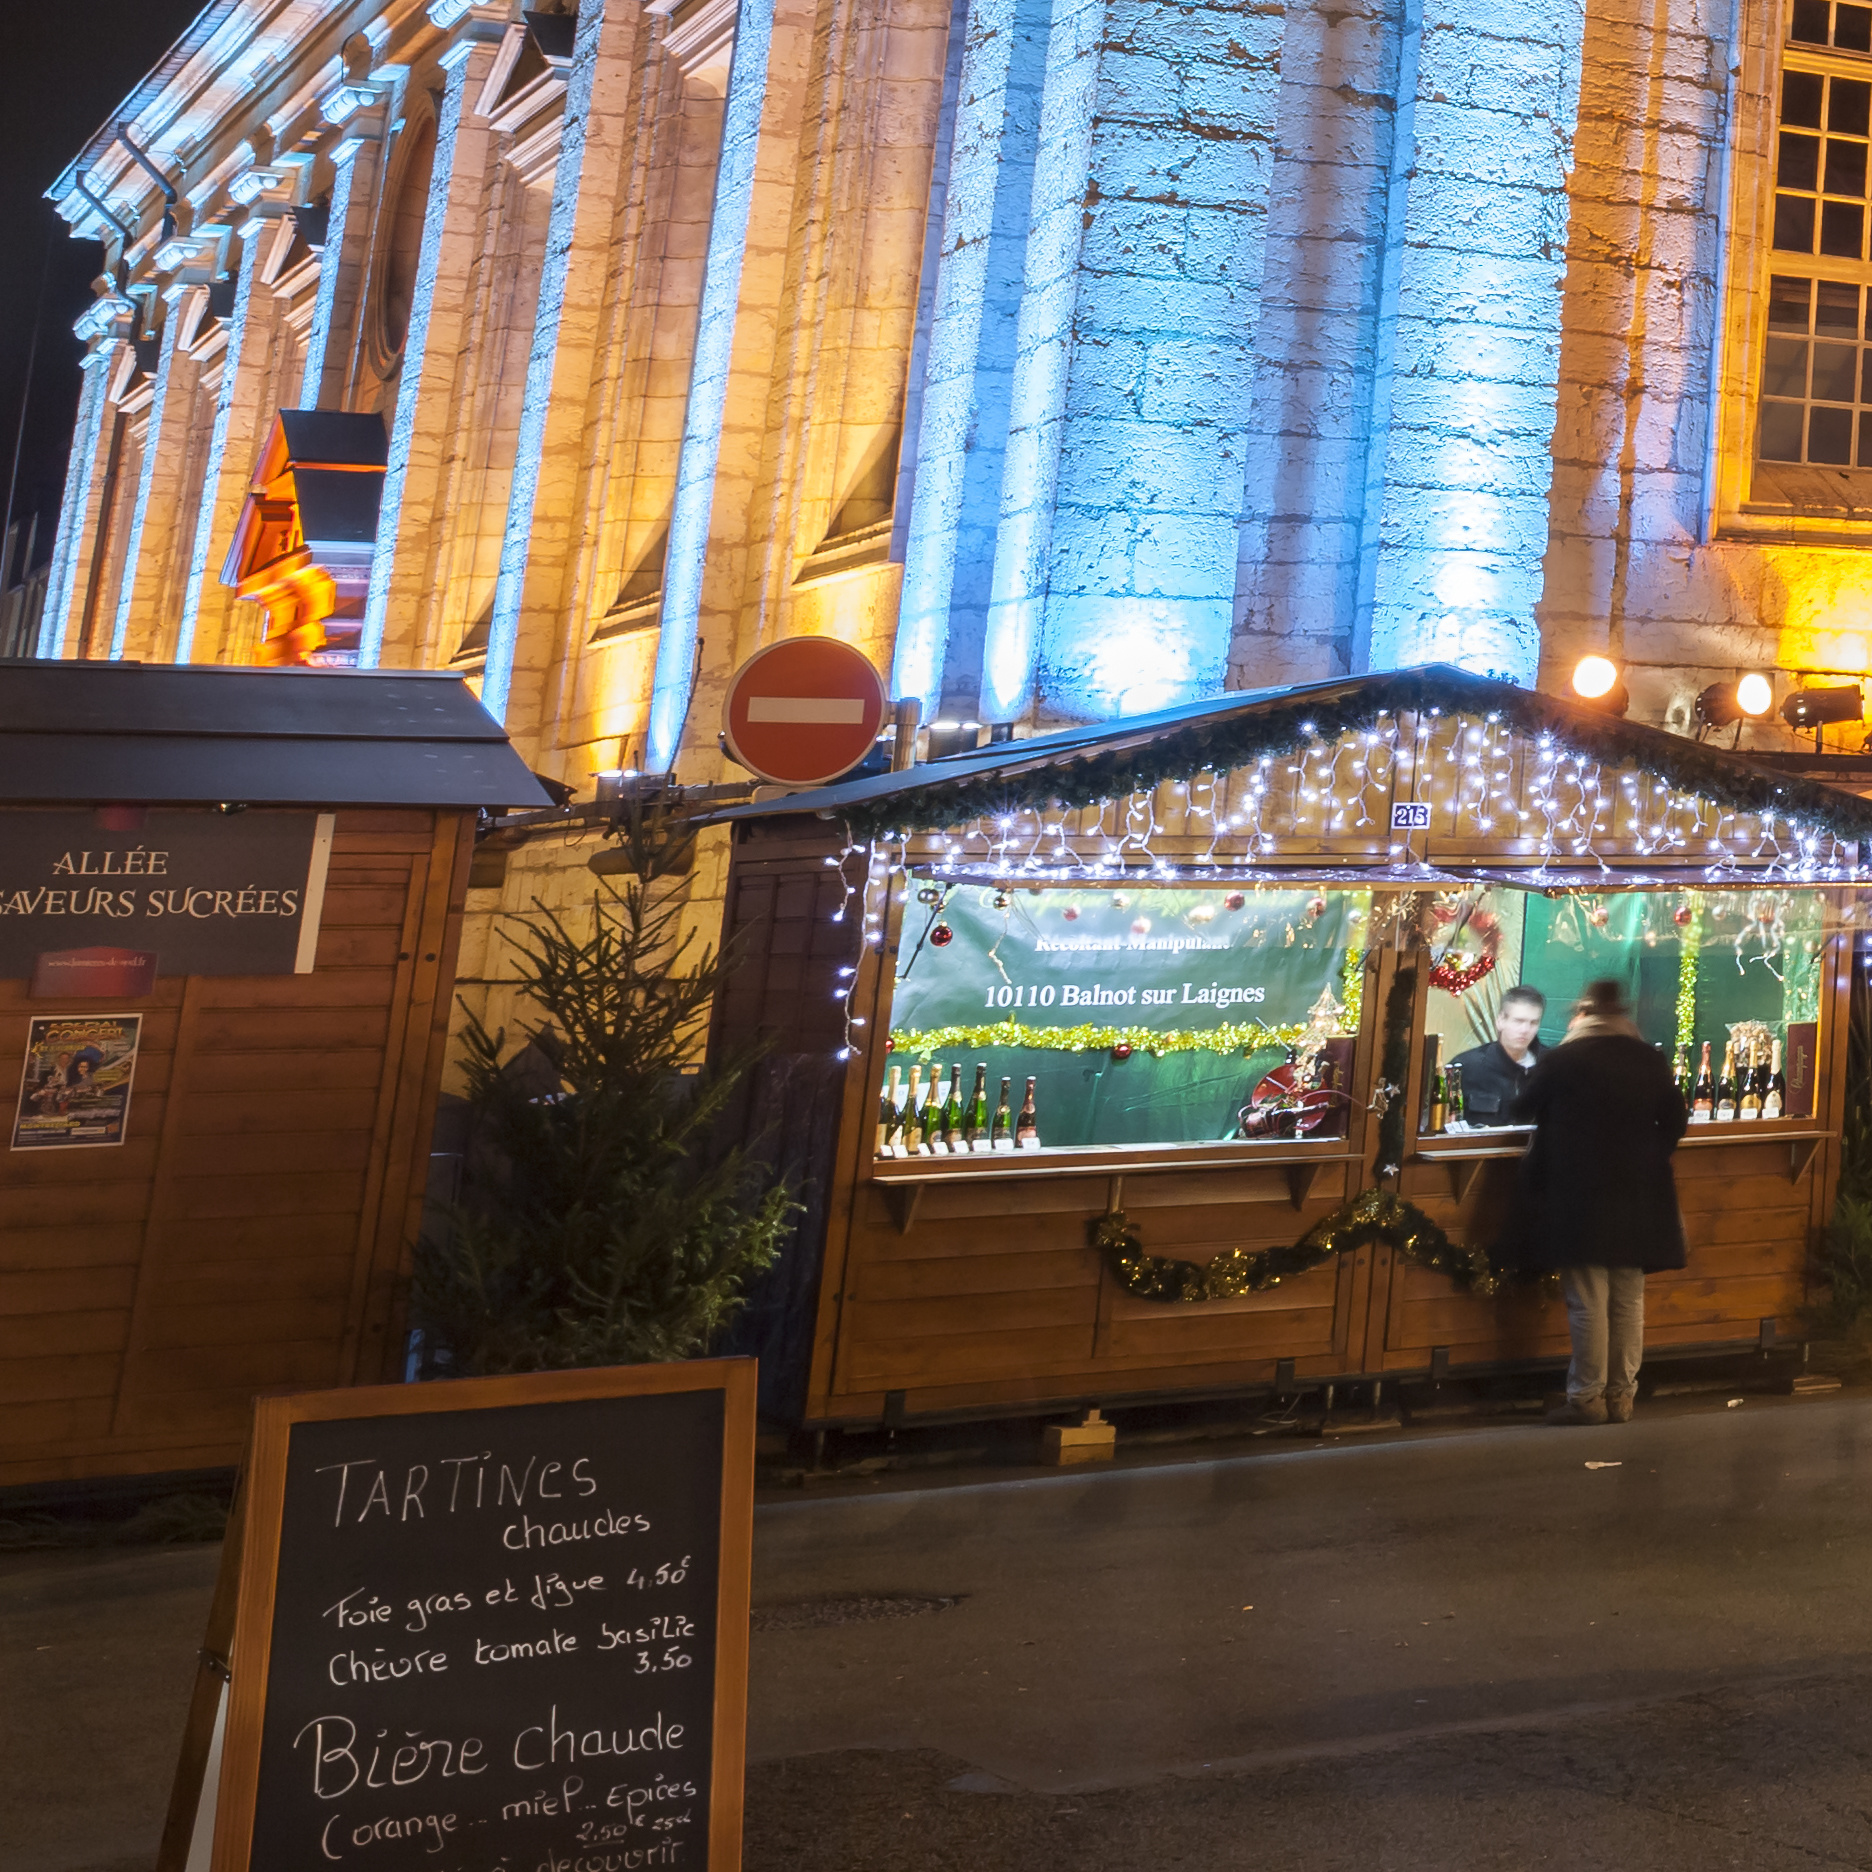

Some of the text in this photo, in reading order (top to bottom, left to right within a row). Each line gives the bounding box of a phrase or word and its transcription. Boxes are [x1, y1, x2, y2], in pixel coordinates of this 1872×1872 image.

[1397, 808, 1425, 825] 215
[52, 845, 169, 876] ALLÉE
[146, 884, 298, 918] SUCRÉES
[985, 981, 1265, 1010] 10110 Balnot sur Laignes
[503, 1509, 651, 1550] chaudes
[322, 1587, 392, 1628] Foie
[406, 1592, 472, 1632] gras
[485, 1578, 519, 1606] et
[531, 1571, 606, 1611] figue
[329, 1647, 449, 1686] Chèvre
[475, 1628, 579, 1666] tomate
[293, 1714, 489, 1800] Bière
